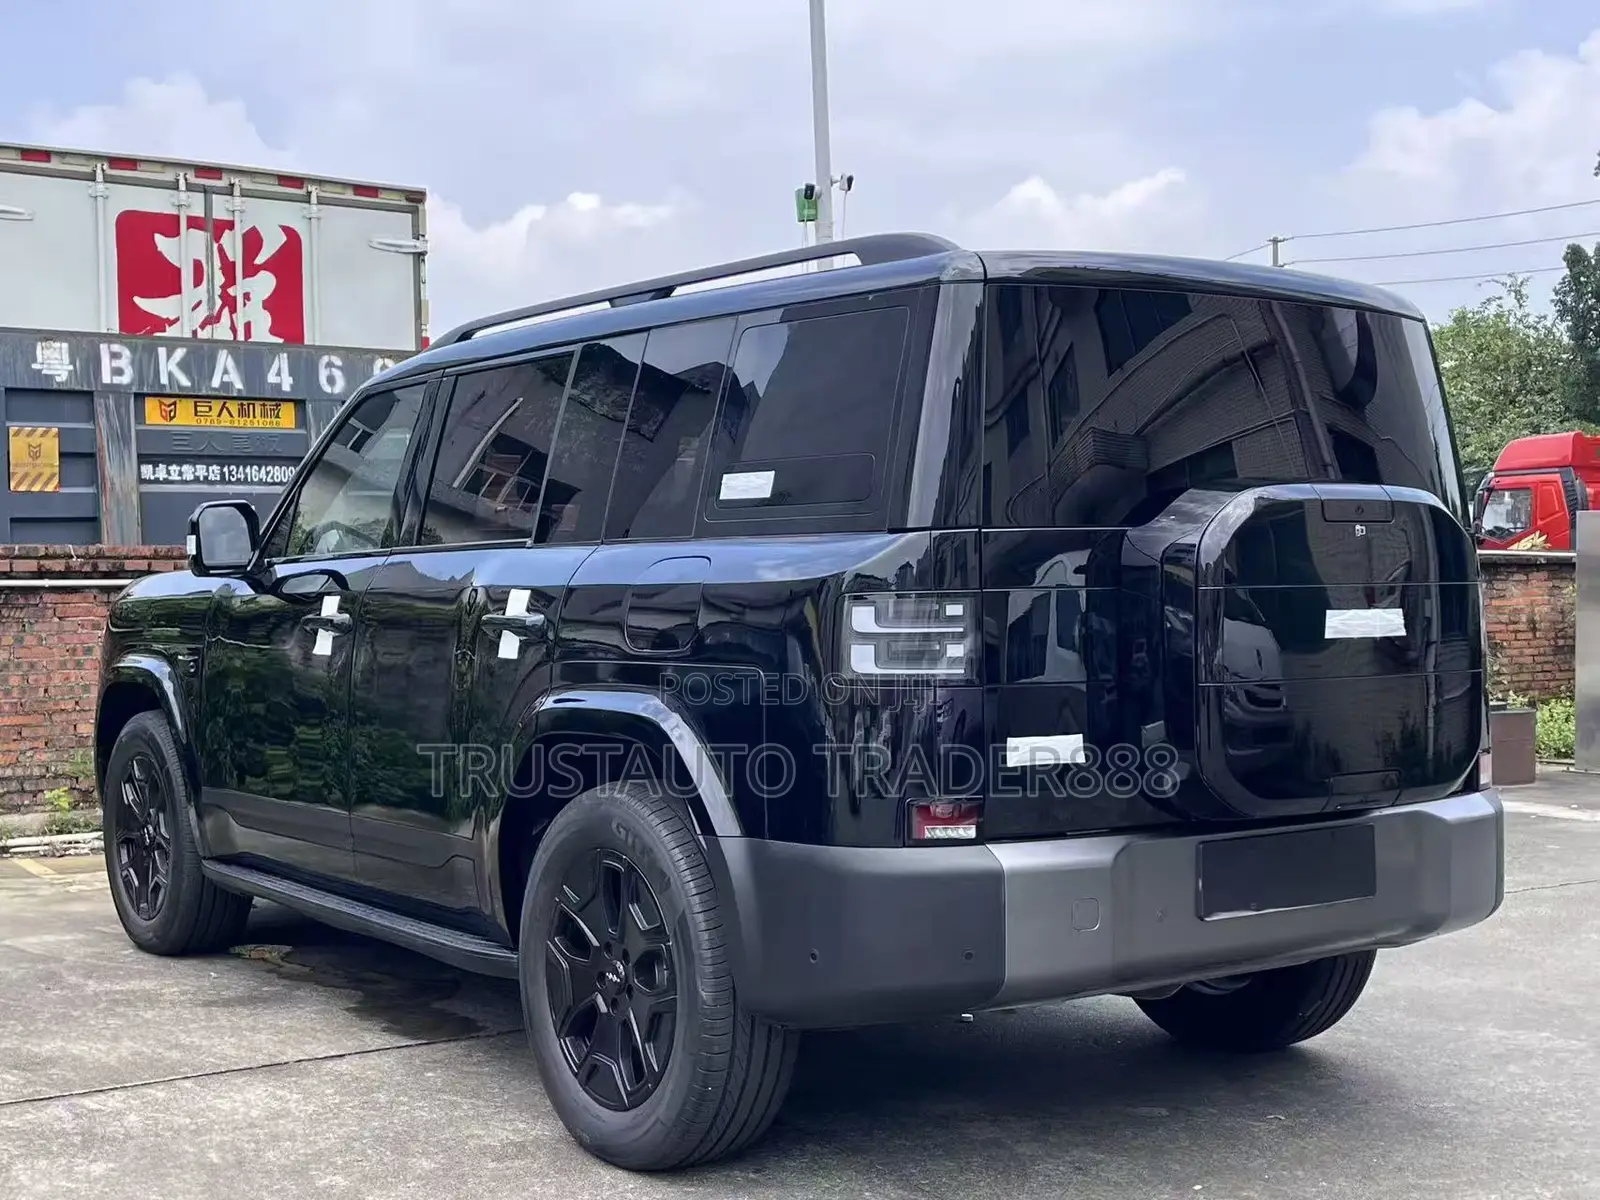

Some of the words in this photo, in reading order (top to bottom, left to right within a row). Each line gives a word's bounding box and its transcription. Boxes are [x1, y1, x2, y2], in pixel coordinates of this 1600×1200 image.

[194, 400, 282, 419] 巨人机械
[140, 463, 221, 481] 凯卓立常平店
[223, 464, 299, 483] 1341642809
